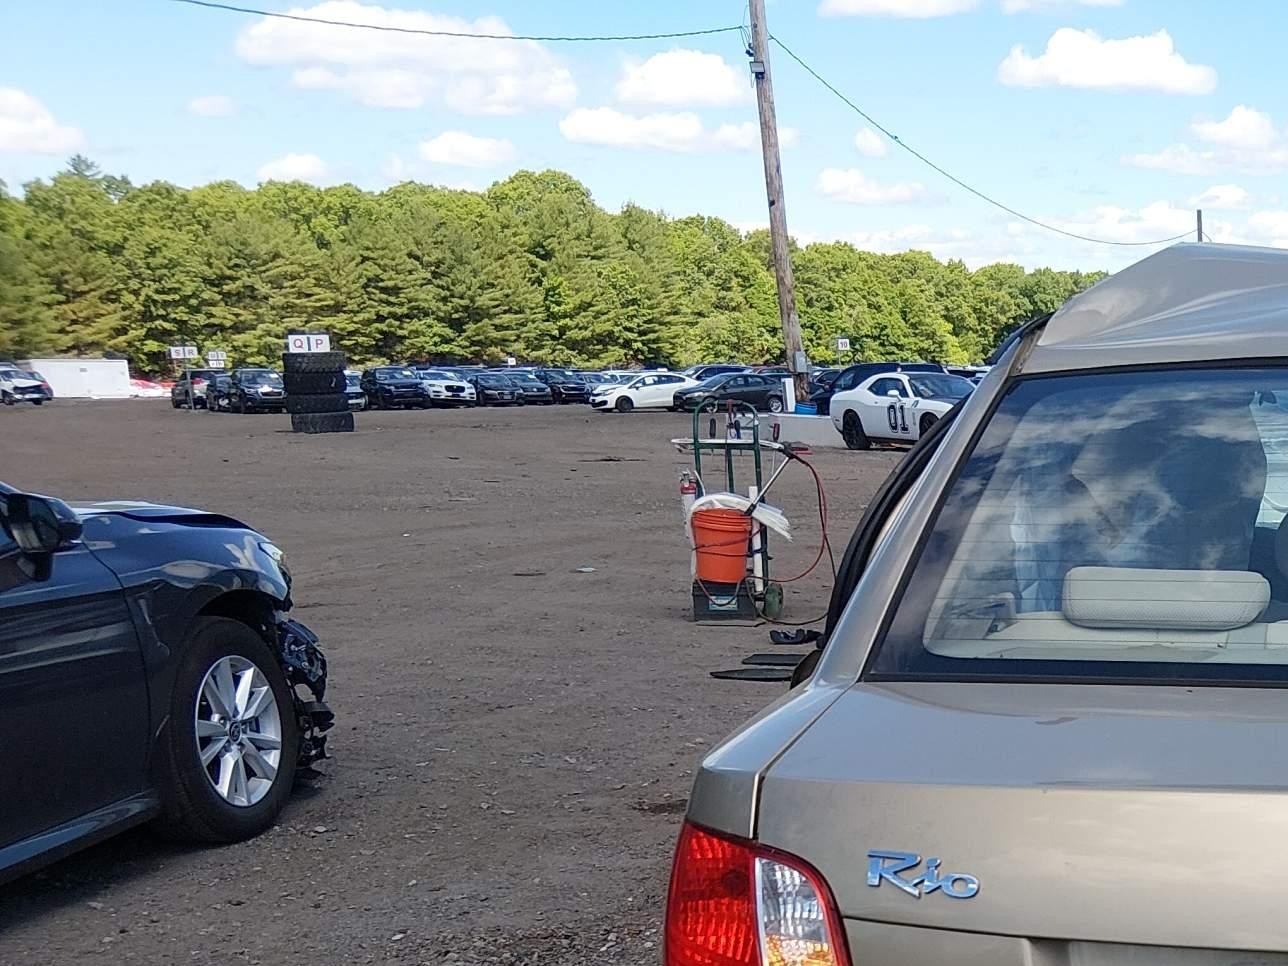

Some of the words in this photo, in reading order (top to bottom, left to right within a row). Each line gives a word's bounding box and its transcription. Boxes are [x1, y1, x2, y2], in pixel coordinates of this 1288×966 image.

[293, 338, 304, 348] Q
[315, 338, 324, 349] P
[887, 402, 910, 434] 01
[867, 848, 980, 899] Rio
